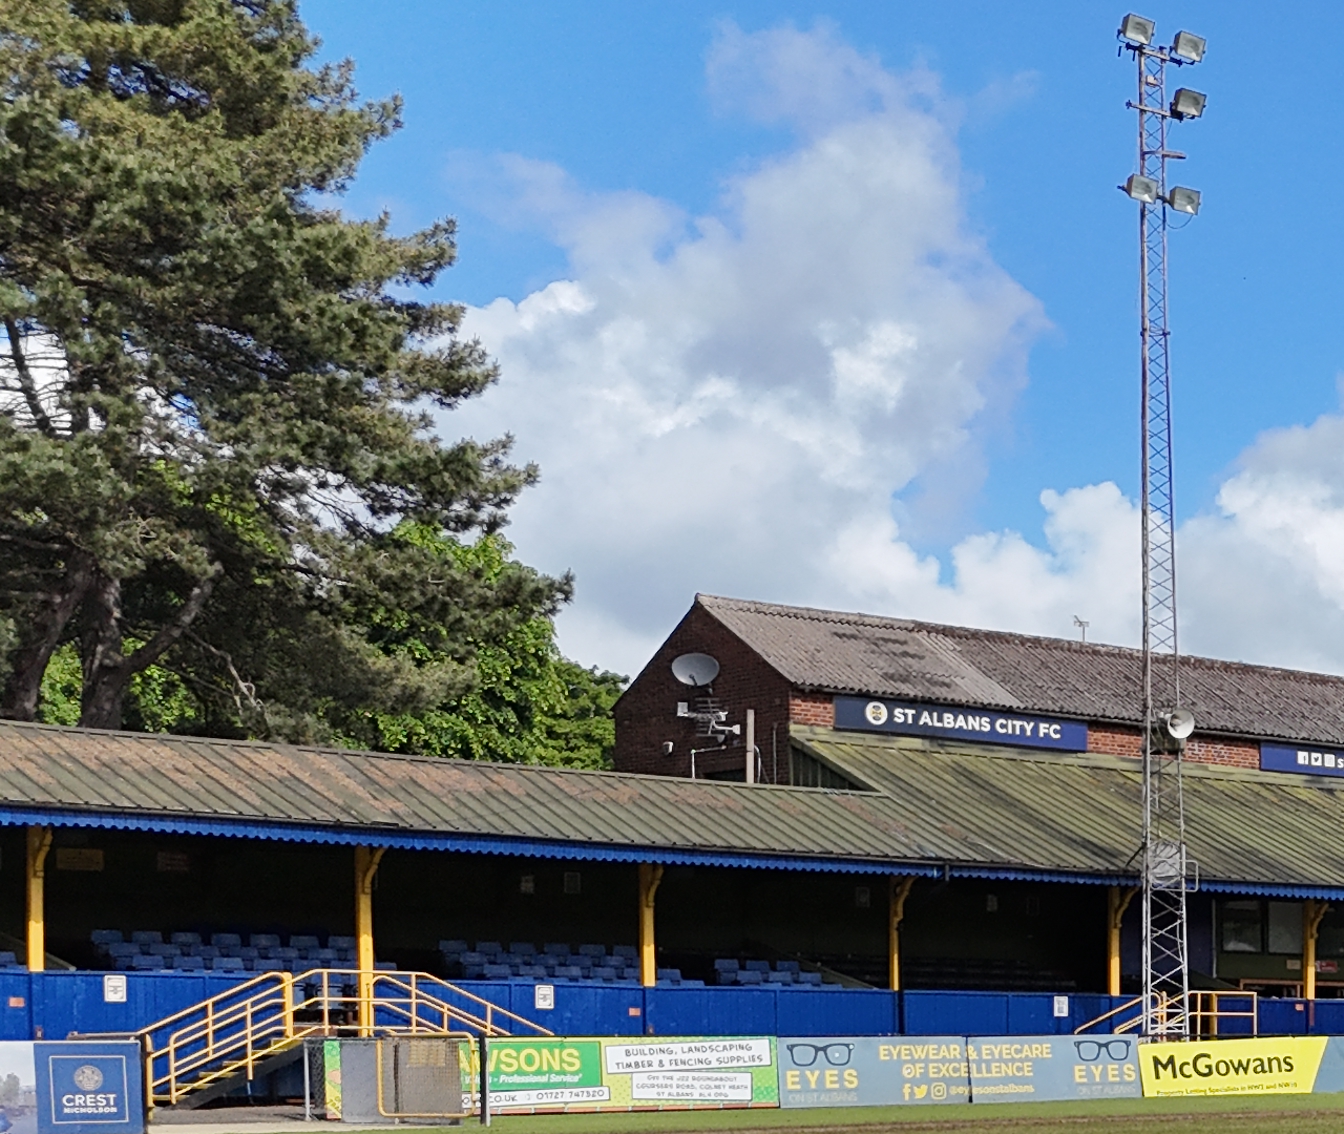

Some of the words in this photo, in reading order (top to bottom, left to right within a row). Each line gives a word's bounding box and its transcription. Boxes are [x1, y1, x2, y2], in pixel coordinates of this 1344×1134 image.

[893, 708, 916, 724] ST
[919, 710, 991, 732] ALBANS
[995, 718, 1034, 737] CITY
[1039, 722, 1061, 739] FC
[624, 1047, 678, 1057] BUILDING,
[681, 1043, 753, 1055] LANDSCAPING
[878, 1044, 961, 1060] EYEWEAR
[967, 1044, 979, 1060] &
[981, 1044, 1052, 1059] EYECARE
[615, 1059, 654, 1070] TIMBER
[658, 1059, 665, 1068] &
[669, 1056, 712, 1067] FENCING
[716, 1054, 763, 1065] SUPPLIES
[902, 1063, 925, 1078] OF
[928, 1062, 1033, 1078] EXCELLENCE
[1152, 1053, 1294, 1080] McGowans
[786, 1069, 859, 1090] EYES
[1073, 1063, 1136, 1083] EYES
[62, 1093, 117, 1107] CREST
[536, 1091, 565, 1100] 01727
